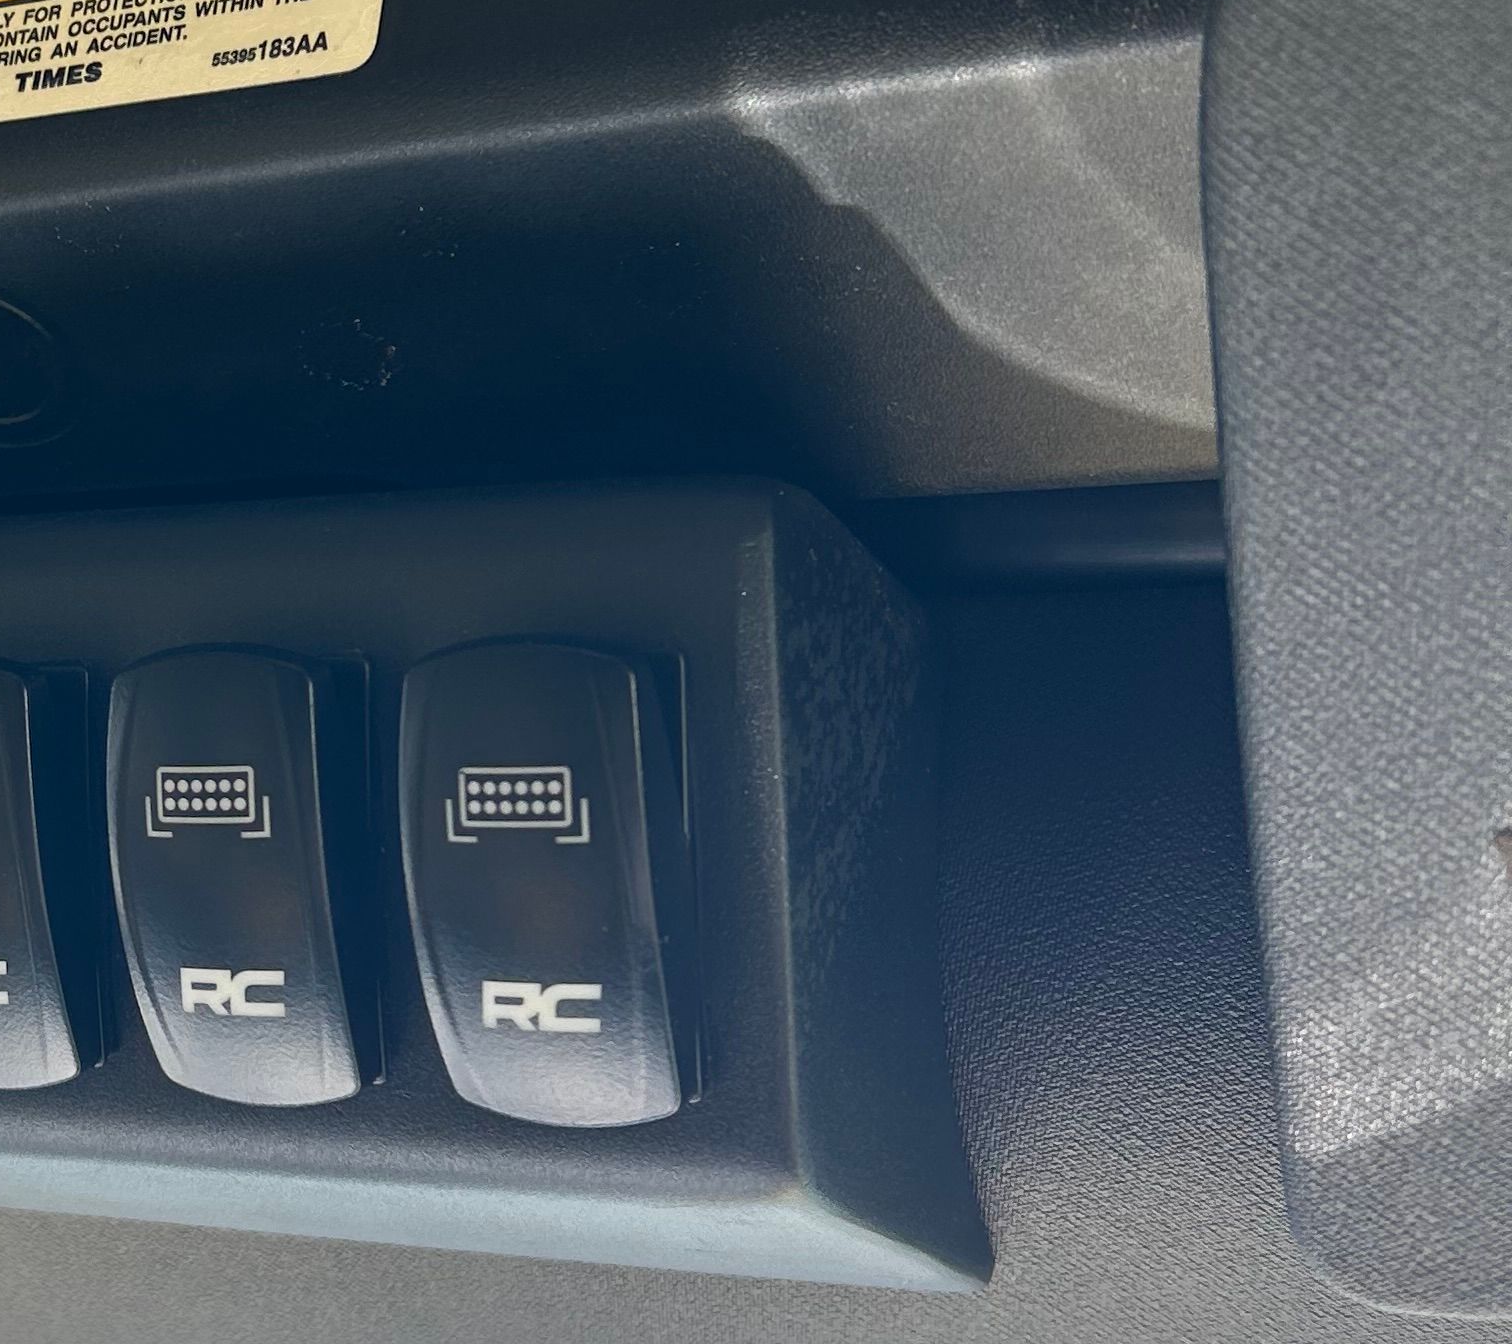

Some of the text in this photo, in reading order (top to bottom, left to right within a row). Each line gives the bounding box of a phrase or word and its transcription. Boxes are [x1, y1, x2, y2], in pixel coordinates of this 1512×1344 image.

[23, 4, 62, 25] FOR
[68, 3, 186, 38] OCCUPANTS
[51, 41, 78, 60] AN
[86, 24, 188, 55] ACCIDENT.
[15, 61, 104, 93] TIMES
[180, 968, 286, 1018] RC
[482, 981, 602, 1033] RC
